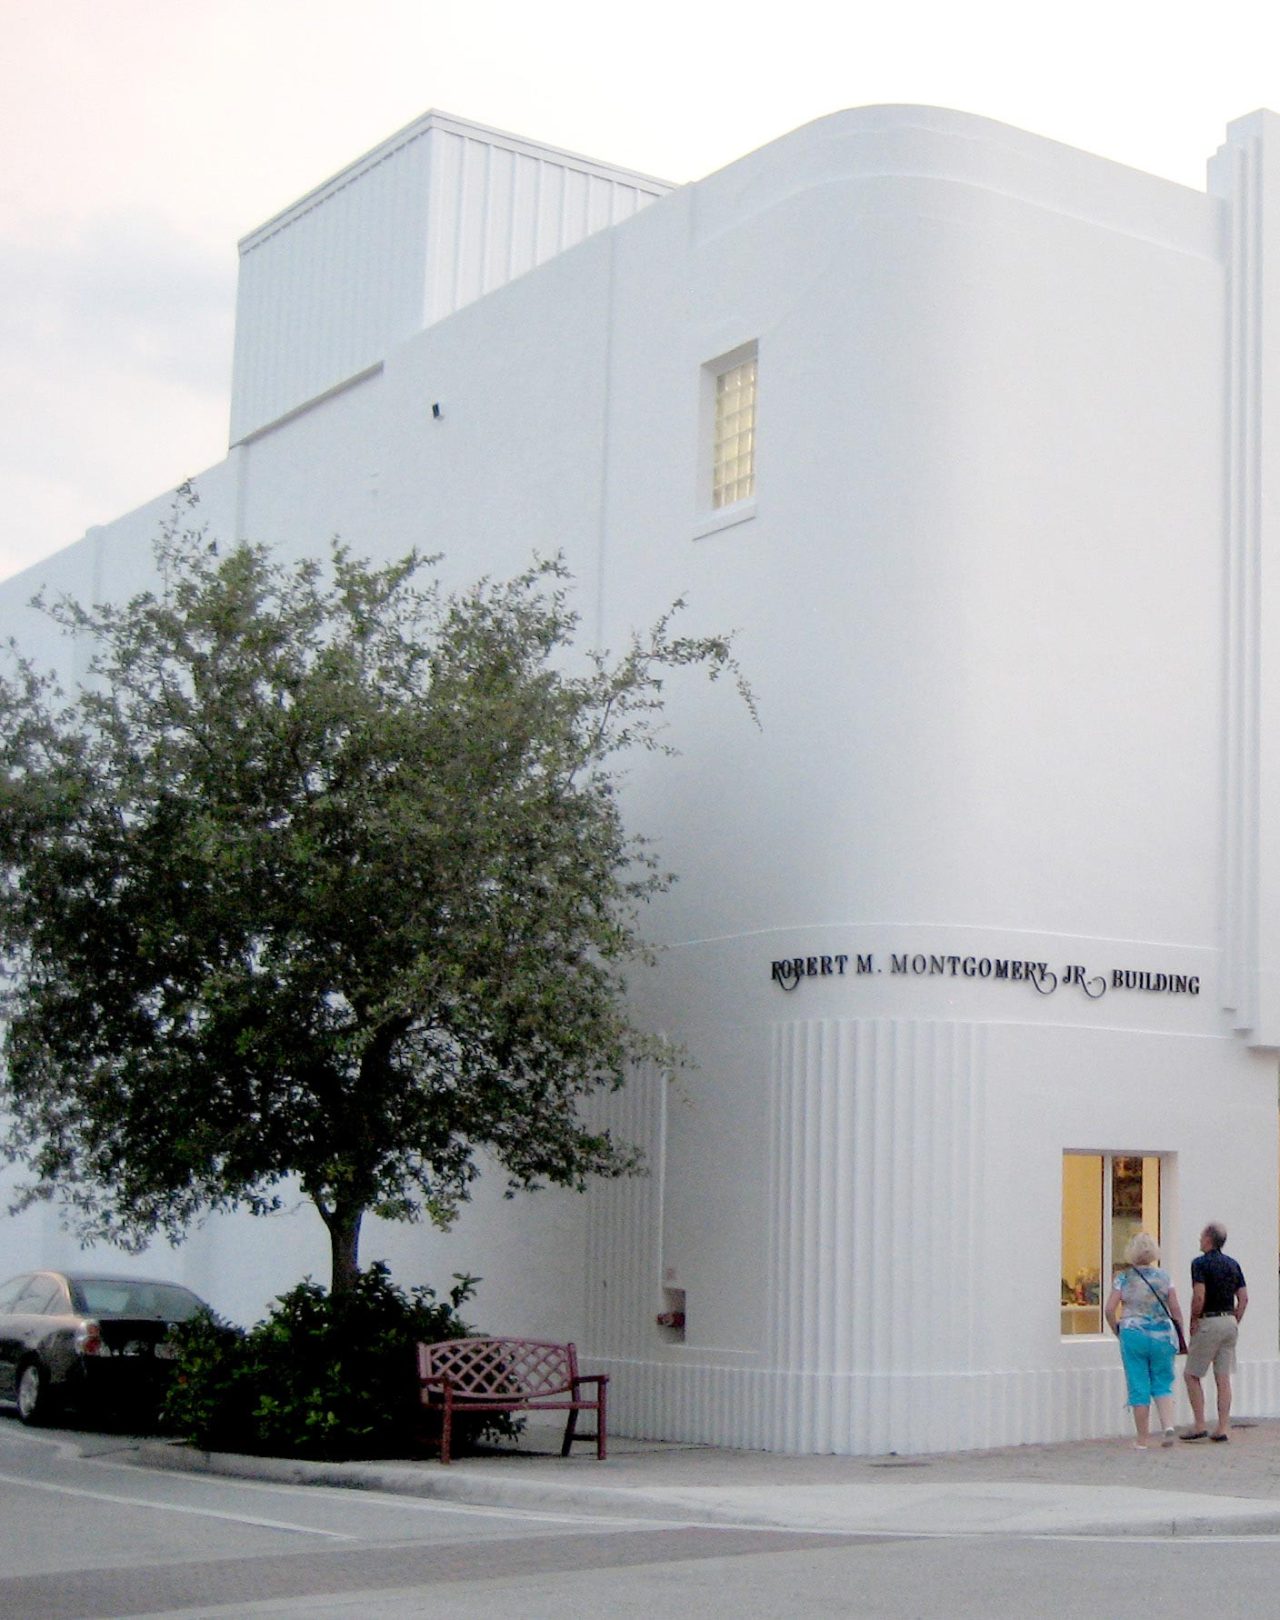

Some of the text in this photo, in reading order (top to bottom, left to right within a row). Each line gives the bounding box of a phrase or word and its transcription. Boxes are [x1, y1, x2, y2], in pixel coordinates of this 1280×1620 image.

[770, 954, 848, 991] ROBERT
[856, 953, 882, 975] M.
[1112, 969, 1201, 995] BUILDING
